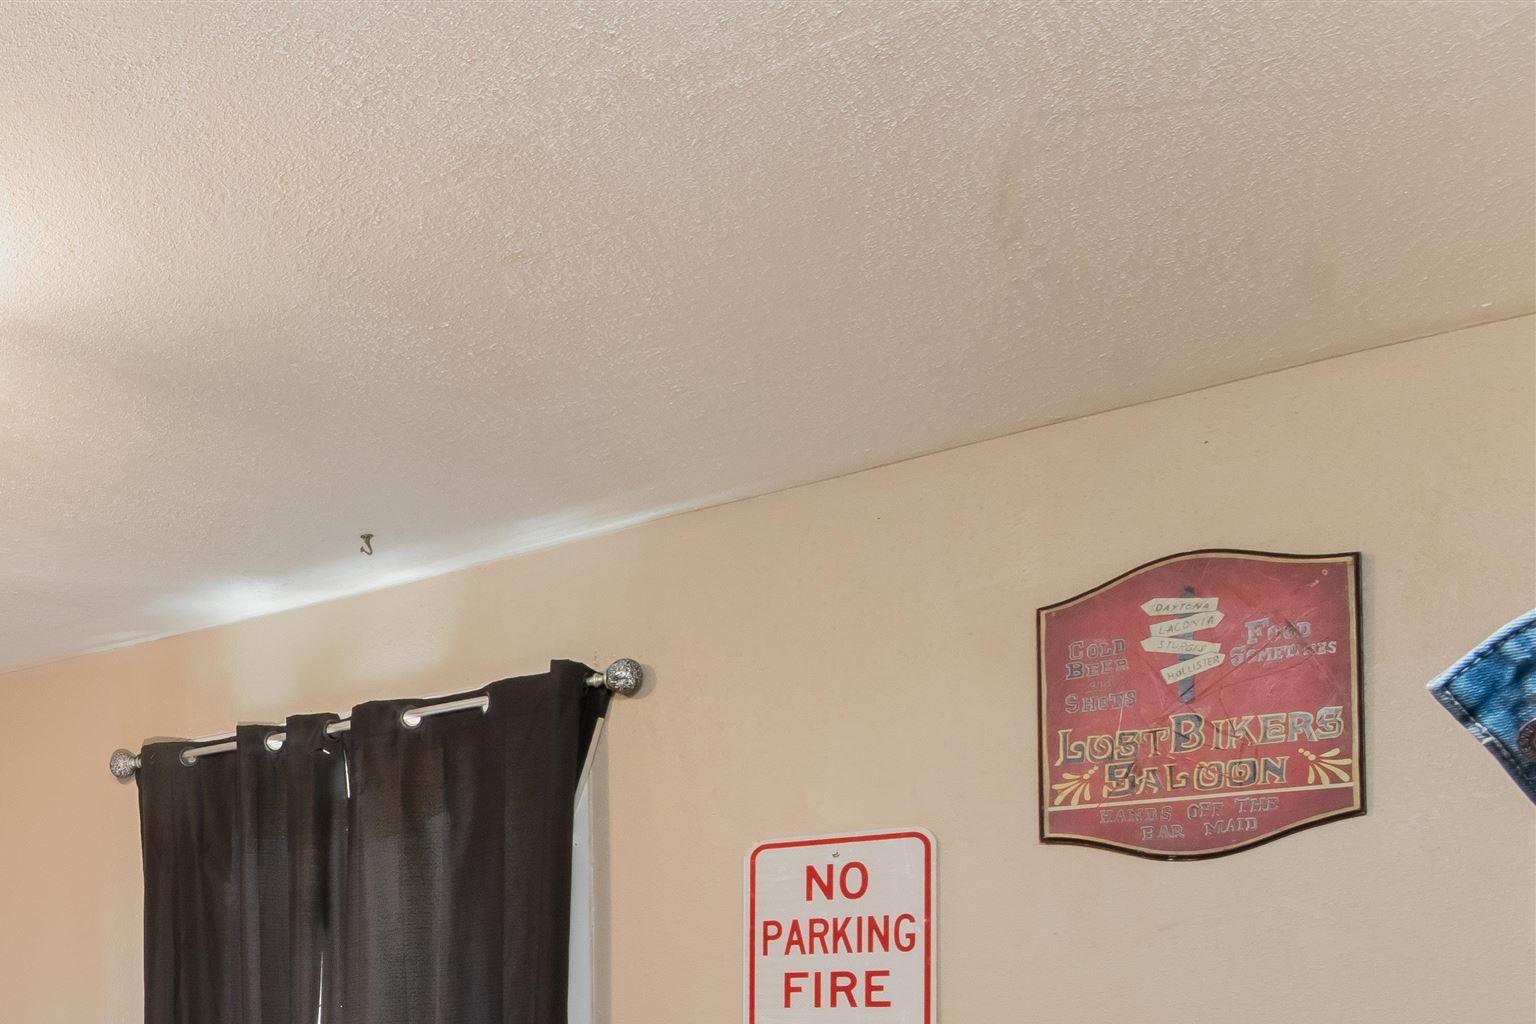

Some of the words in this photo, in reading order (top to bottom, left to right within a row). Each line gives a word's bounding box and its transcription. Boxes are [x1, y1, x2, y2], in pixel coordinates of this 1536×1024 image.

[1154, 603, 1211, 612] DAYTONA
[1158, 616, 1215, 635] LACONIA
[1166, 655, 1220, 681] HOLLISTER
[1055, 729, 1170, 766] LOST
[1169, 706, 1344, 753] BIKERS
[1103, 756, 1290, 797] SALOON
[1098, 805, 1173, 824] HANDS
[1187, 802, 1224, 819] OFF
[1234, 797, 1280, 813] THE
[805, 861, 869, 901] NO
[762, 913, 917, 956] PARKING
[783, 970, 892, 1008] FIRE
